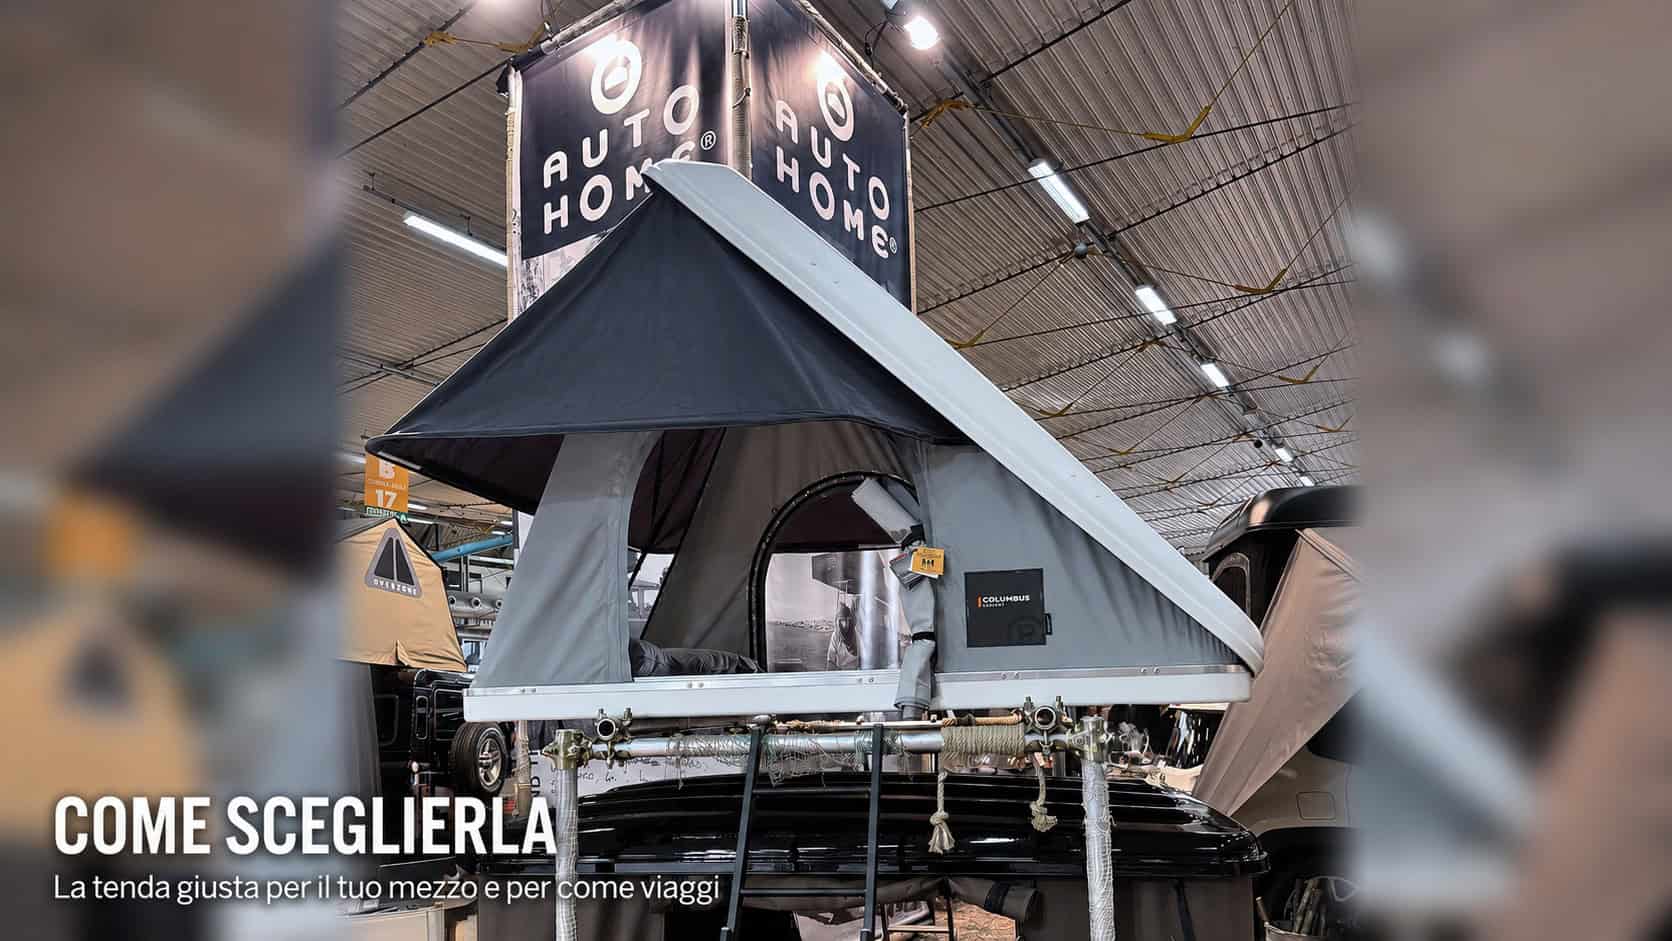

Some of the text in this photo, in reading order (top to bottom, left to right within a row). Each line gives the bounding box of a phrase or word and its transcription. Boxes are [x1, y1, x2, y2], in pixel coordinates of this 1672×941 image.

[543, 85, 699, 188] AUTO
[776, 100, 890, 221] AUTO
[376, 489, 398, 508] 17
[983, 594, 1030, 603] COLUMBUS
